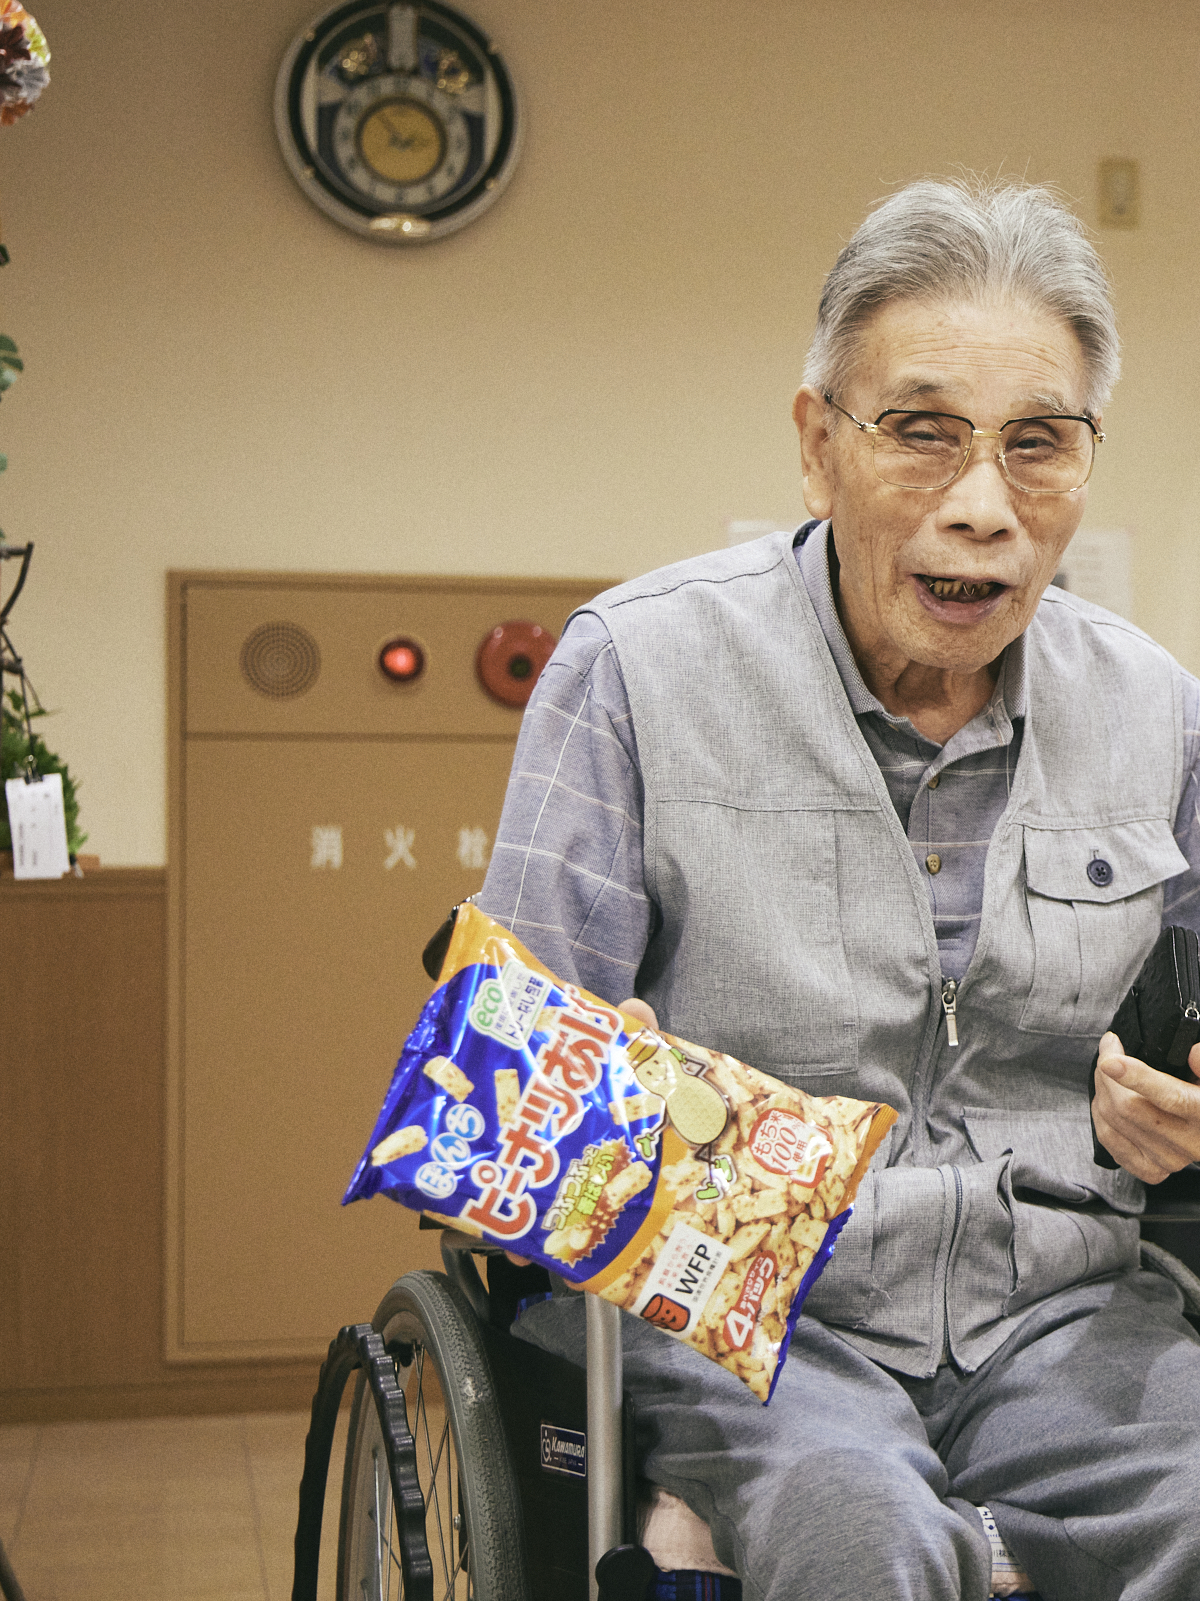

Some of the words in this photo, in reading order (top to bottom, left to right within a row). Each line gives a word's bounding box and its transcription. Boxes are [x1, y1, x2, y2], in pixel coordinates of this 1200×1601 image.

[310, 825, 488, 870] 消火栓
[475, 985, 502, 1027] eco
[465, 983, 618, 1234] ピーナツあげ
[753, 1111, 782, 1155] もち米
[790, 1139, 808, 1162] 使用
[542, 1145, 599, 1231] つぶつぶっと
[574, 1152, 615, 1215] 香ばしい
[673, 1243, 711, 1294] WFP
[725, 1256, 774, 1347] 4パック
